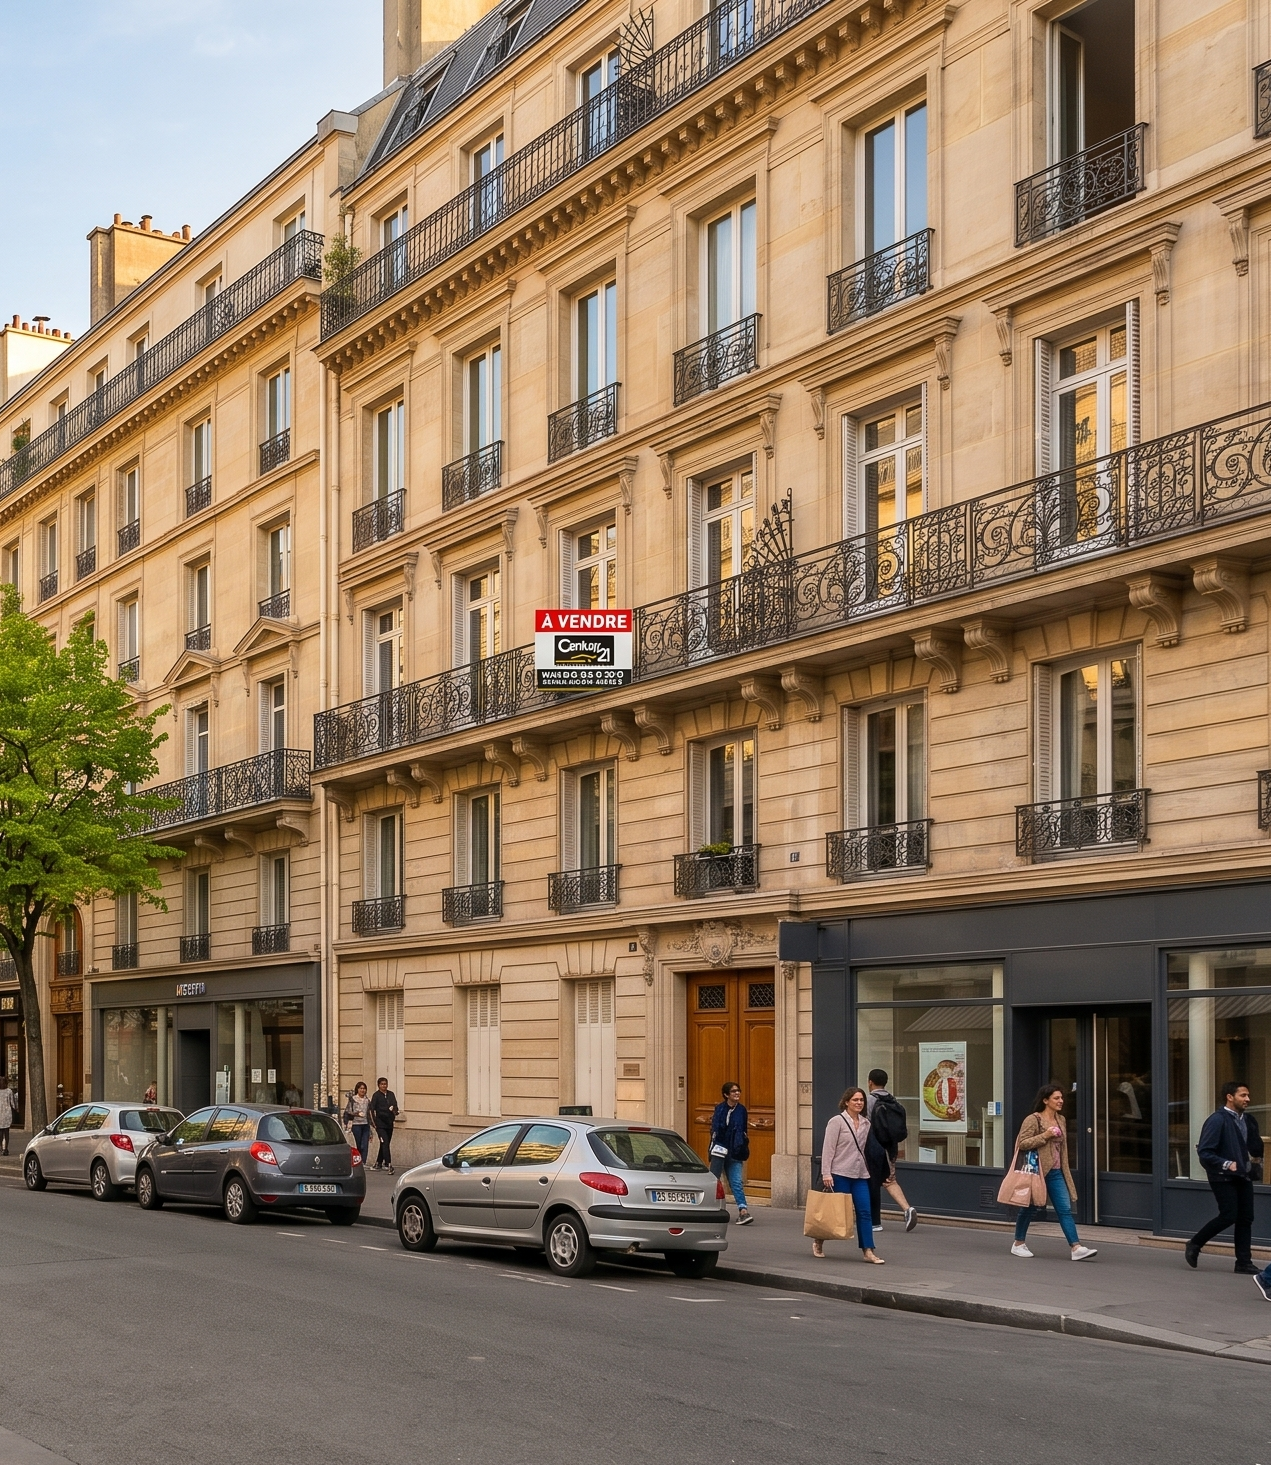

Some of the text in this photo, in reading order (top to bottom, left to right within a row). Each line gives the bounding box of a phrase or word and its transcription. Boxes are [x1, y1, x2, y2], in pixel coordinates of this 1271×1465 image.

[541, 613, 627, 629] À VENDRE
[597, 647, 610, 662] 21
